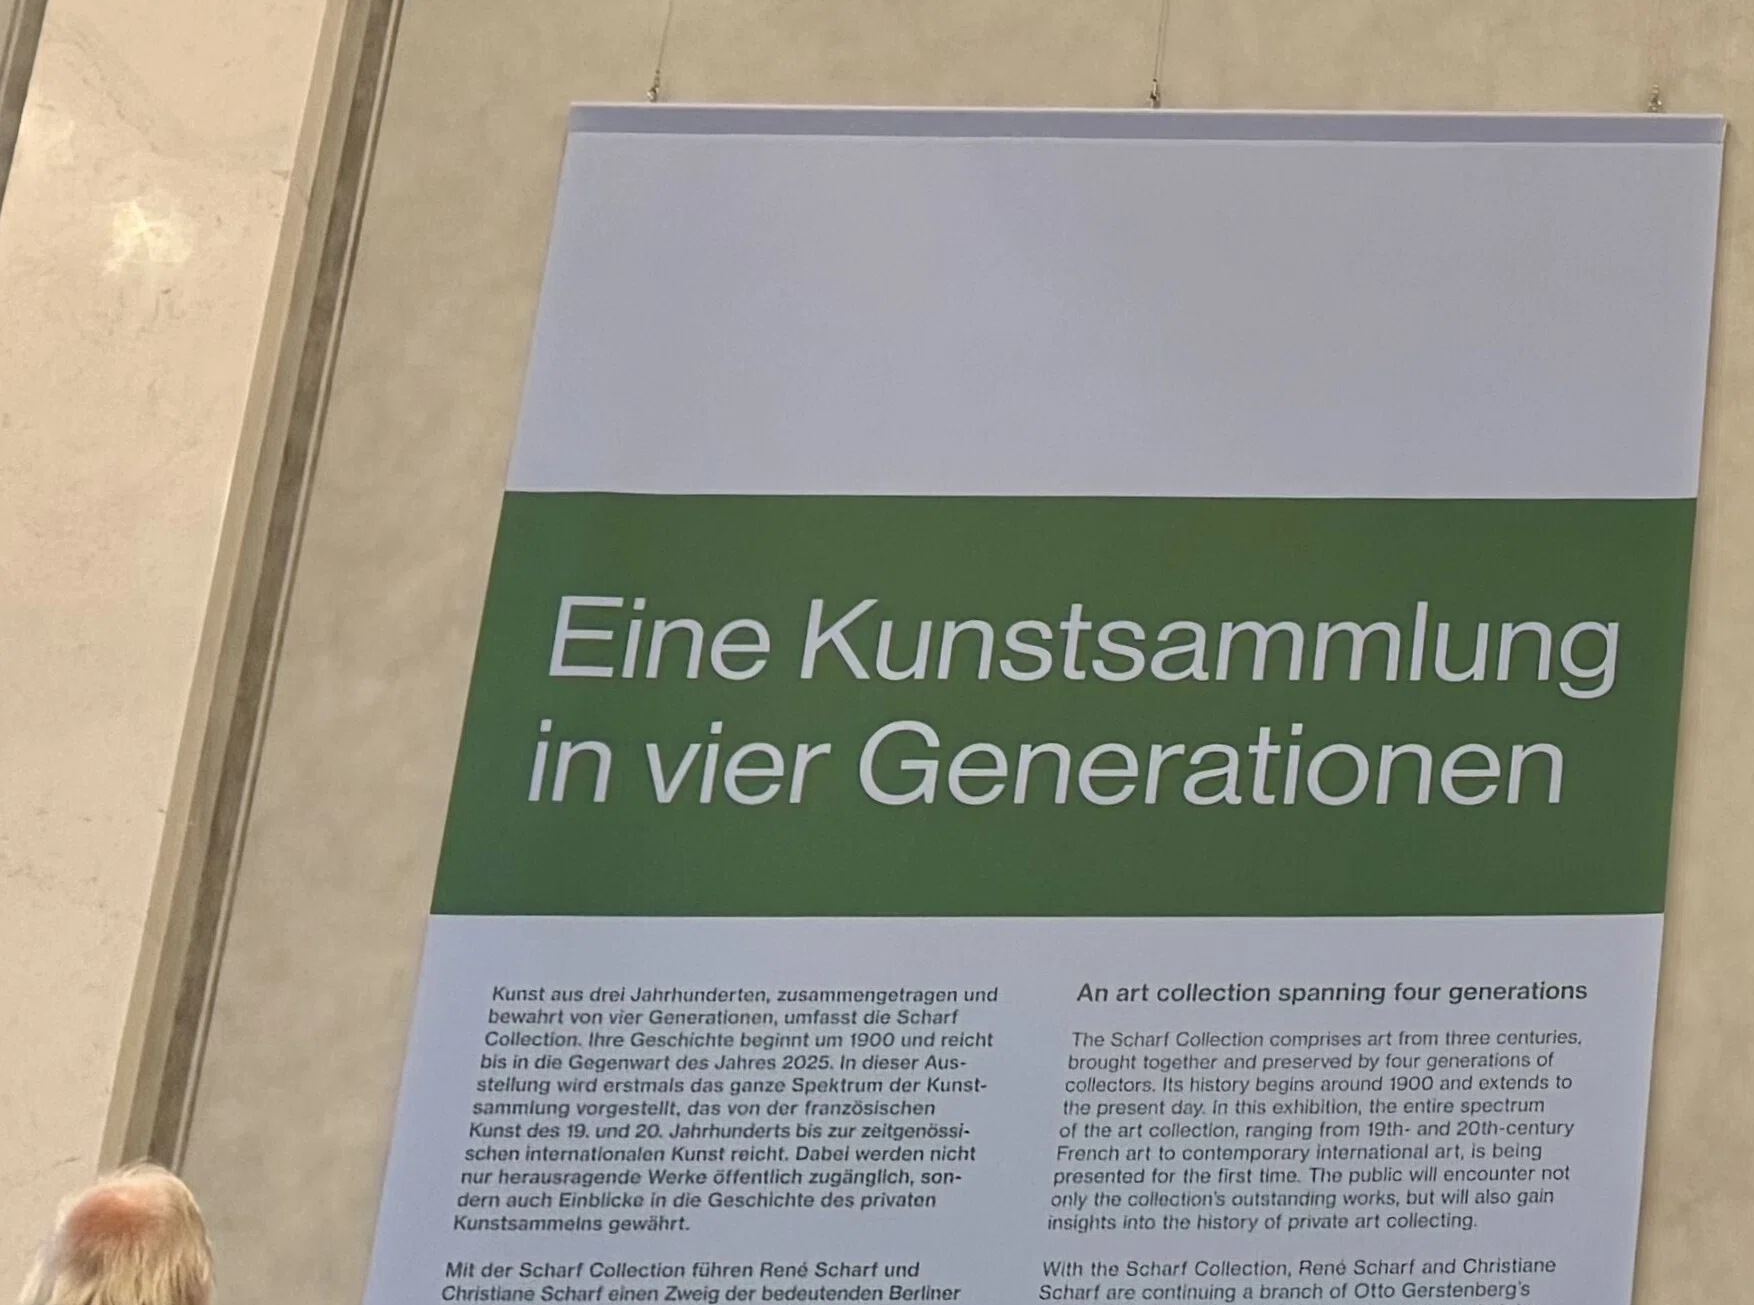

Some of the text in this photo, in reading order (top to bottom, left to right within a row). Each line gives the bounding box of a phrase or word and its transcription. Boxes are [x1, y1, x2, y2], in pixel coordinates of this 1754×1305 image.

[550, 596, 1620, 701] Eine Kunstsammlung
[529, 720, 1564, 808] in vier Generationen
[492, 985, 999, 1006] Kunst aus drei Jahrhunderten, zusammengetragen und
[1076, 980, 1588, 1006] An art collection spanning four generations
[484, 1030, 994, 1051] Collection. Ihre Geschichte beginnt um 1900 und reicht
[1071, 1029, 1582, 1050] The Scharf Collection comprises art from three centuries,
[476, 1076, 988, 1097] stellung wird erstmals das ganze Spektrum der Kunst-
[1065, 1073, 1573, 1096] collectors. Its history begins around 1900 and extends to
[468, 1121, 971, 1142] Kunst des 19. und 20. Jahrhunderts bis zur zeitgenössi-
[1058, 1120, 1575, 1142] of the art collection, ranging from 19th- and 20th-century
[460, 1168, 963, 1189] nur herausragende Werke öffentlich zugänglich, son-
[453, 1214, 691, 1235] Kunstsammelns gewährt.
[1047, 1211, 1478, 1235] insights into the history of private art collecting.
[445, 1260, 921, 1279] Mit der Scharf Collection führen René Scharf und
[441, 1284, 962, 1305] Christiane Scharf einen Zweig der bedeutenden Berliner
[1038, 1280, 1531, 1304] Scharf are continuing a branch of Otto Gerstenberg's
